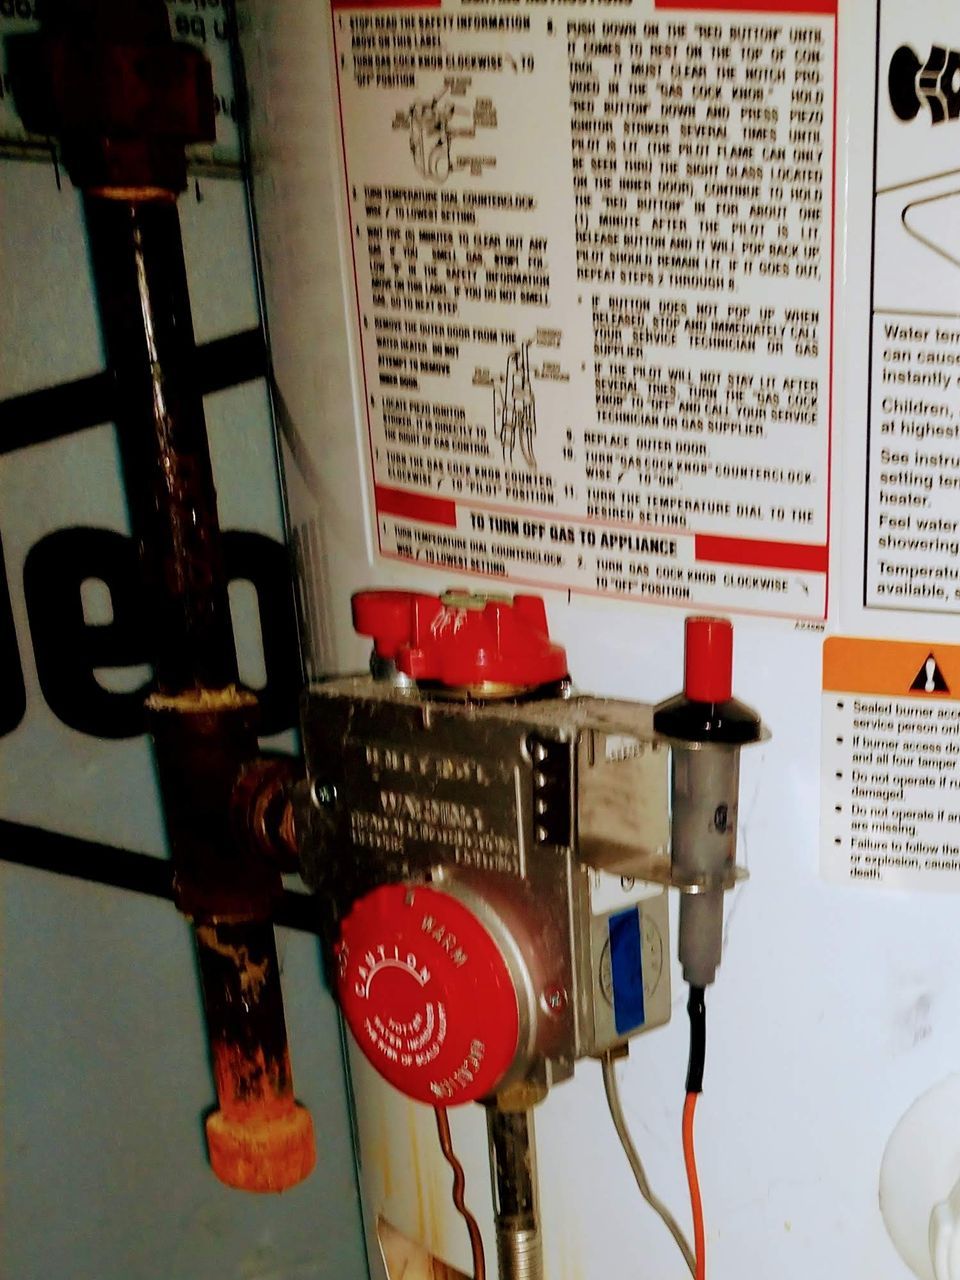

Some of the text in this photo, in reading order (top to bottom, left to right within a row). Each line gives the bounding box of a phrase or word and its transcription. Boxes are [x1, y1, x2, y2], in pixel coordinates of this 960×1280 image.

[884, 324, 928, 342] Water
[883, 350, 910, 363] can
[883, 368, 950, 391] instantly
[881, 419, 894, 434] at
[900, 420, 958, 440] highest
[881, 450, 908, 466] See
[880, 470, 932, 491] setting
[879, 514, 910, 530] Feel
[916, 516, 956, 532] water
[470, 514, 678, 556] TO TURN OFF GAS TO APPLIANCE
[854, 700, 891, 715] Sealed
[895, 702, 932, 718] burner
[853, 717, 893, 731] service
[897, 721, 937, 735] person
[852, 734, 859, 748] If
[862, 735, 898, 750] burner
[903, 740, 941, 752] access
[852, 750, 872, 764] and
[876, 751, 888, 765] all
[892, 752, 913, 766] four
[918, 754, 955, 771] tamper
[852, 768, 867, 783] Do
[871, 771, 888, 784] not
[892, 773, 935, 789] operate
[939, 774, 946, 788] if
[851, 802, 866, 816] Do
[870, 804, 887, 818] not
[891, 807, 933, 822] operate
[937, 808, 944, 821] if
[851, 820, 867, 831] are
[851, 834, 887, 850] Failure
[891, 837, 901, 850] to
[905, 838, 938, 852] follow
[942, 840, 958, 853] the
[850, 852, 860, 863] or
[421, 914, 468, 968] WARM
[355, 944, 431, 997] CAUTION
